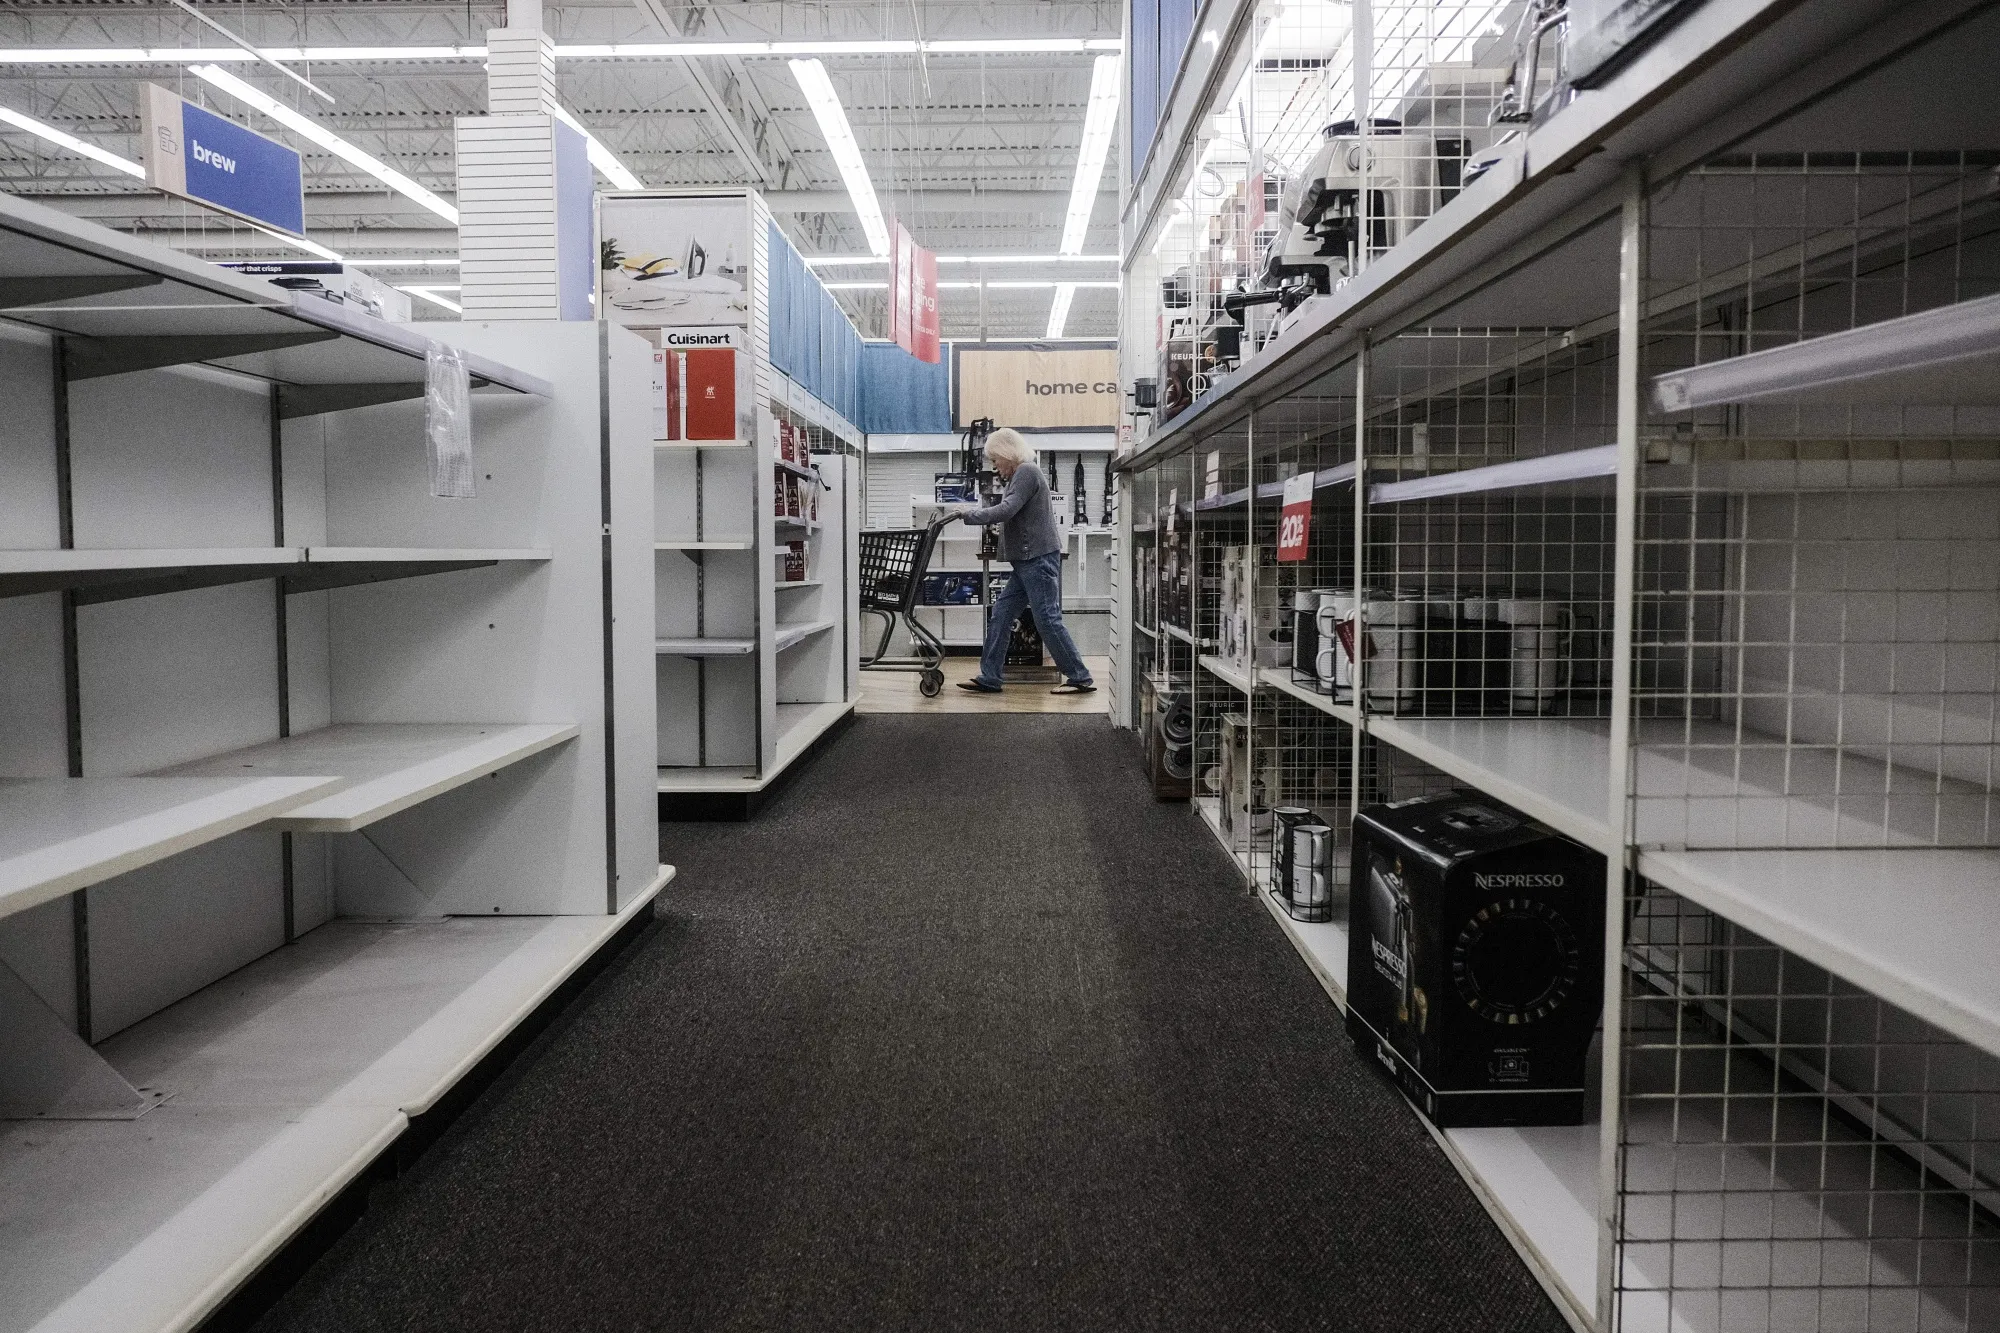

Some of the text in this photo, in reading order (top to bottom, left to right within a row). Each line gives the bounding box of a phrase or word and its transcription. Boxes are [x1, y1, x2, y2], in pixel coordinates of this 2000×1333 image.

[193, 140, 236, 174] brew
[668, 333, 731, 345] Cuisinart
[1171, 353, 1203, 361] KEURG
[1026, 380, 1088, 396] home
[1473, 872, 1564, 890] NESPRESSO
